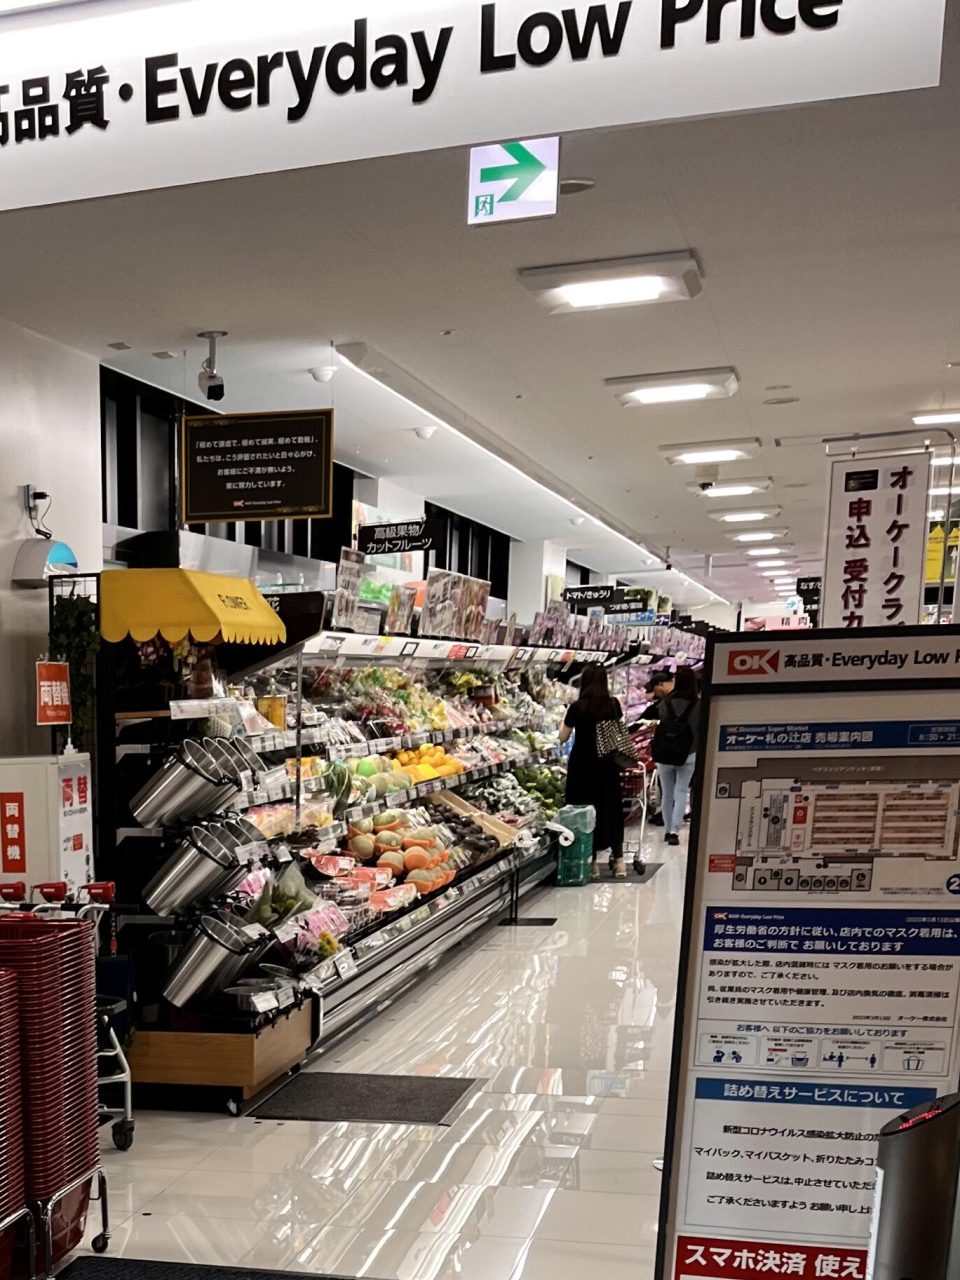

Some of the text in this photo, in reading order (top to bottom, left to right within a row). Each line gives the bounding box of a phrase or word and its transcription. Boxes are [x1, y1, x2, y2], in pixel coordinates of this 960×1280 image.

[480, 0, 633, 73] Low
[366, 537, 432, 554] カットフルーツ
[881, 465, 913, 626] オーケークラ
[732, 649, 780, 675] OK
[914, 649, 949, 665] Low
[723, 1083, 905, 1105] 詰め替えサービスについて
[684, 1244, 807, 1276] スマホ決済
